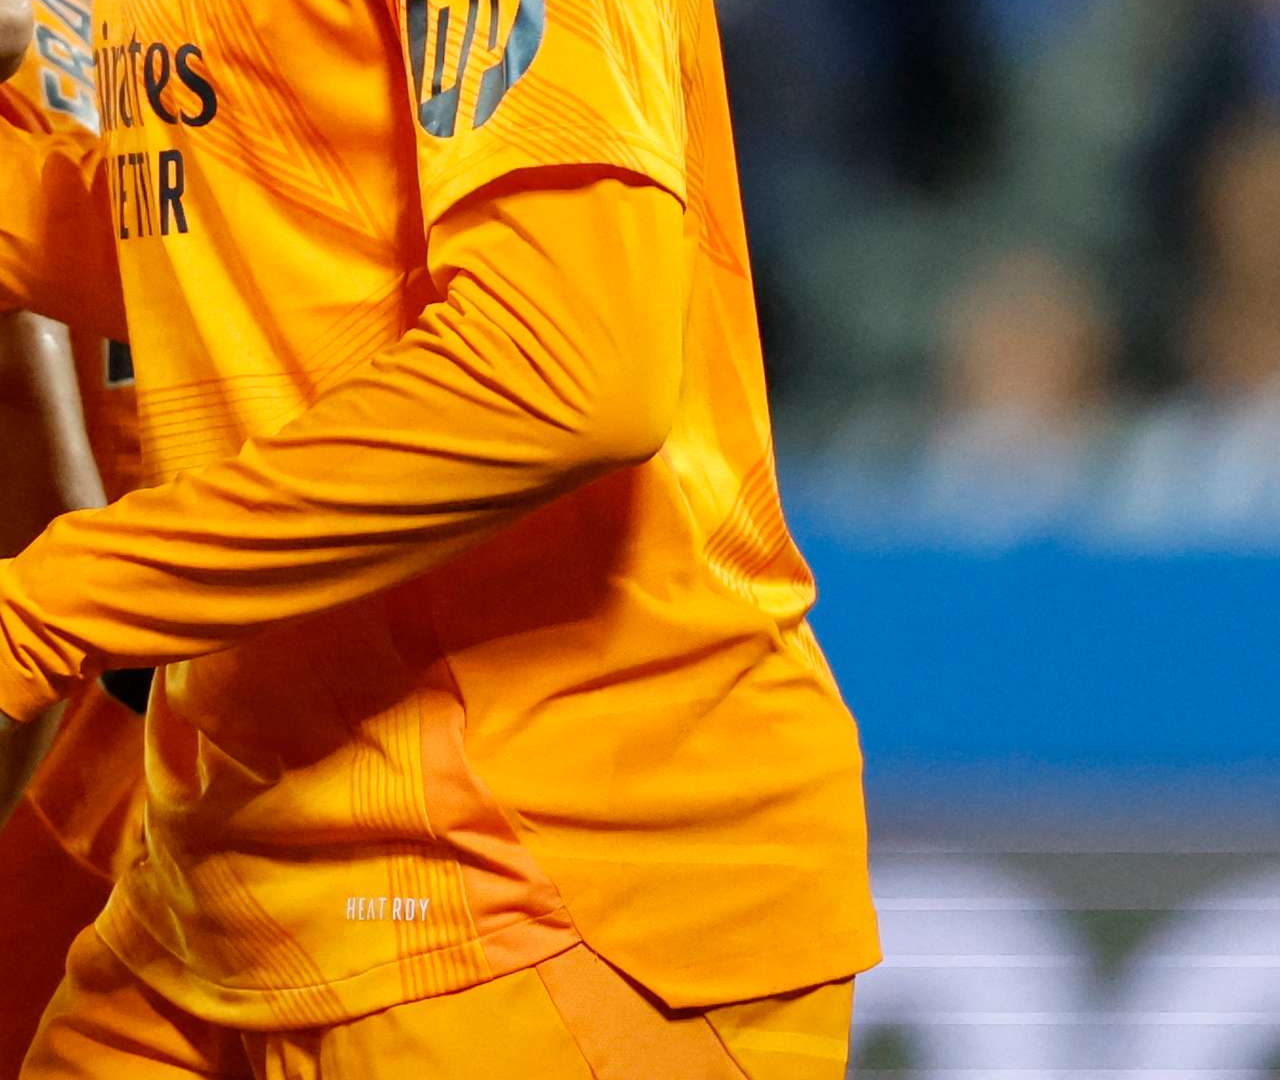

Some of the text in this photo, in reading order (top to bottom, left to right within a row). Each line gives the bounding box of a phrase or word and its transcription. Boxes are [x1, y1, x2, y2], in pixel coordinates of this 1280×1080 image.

[95, 19, 218, 132] irates
[346, 896, 430, 922] HEAT RDY
